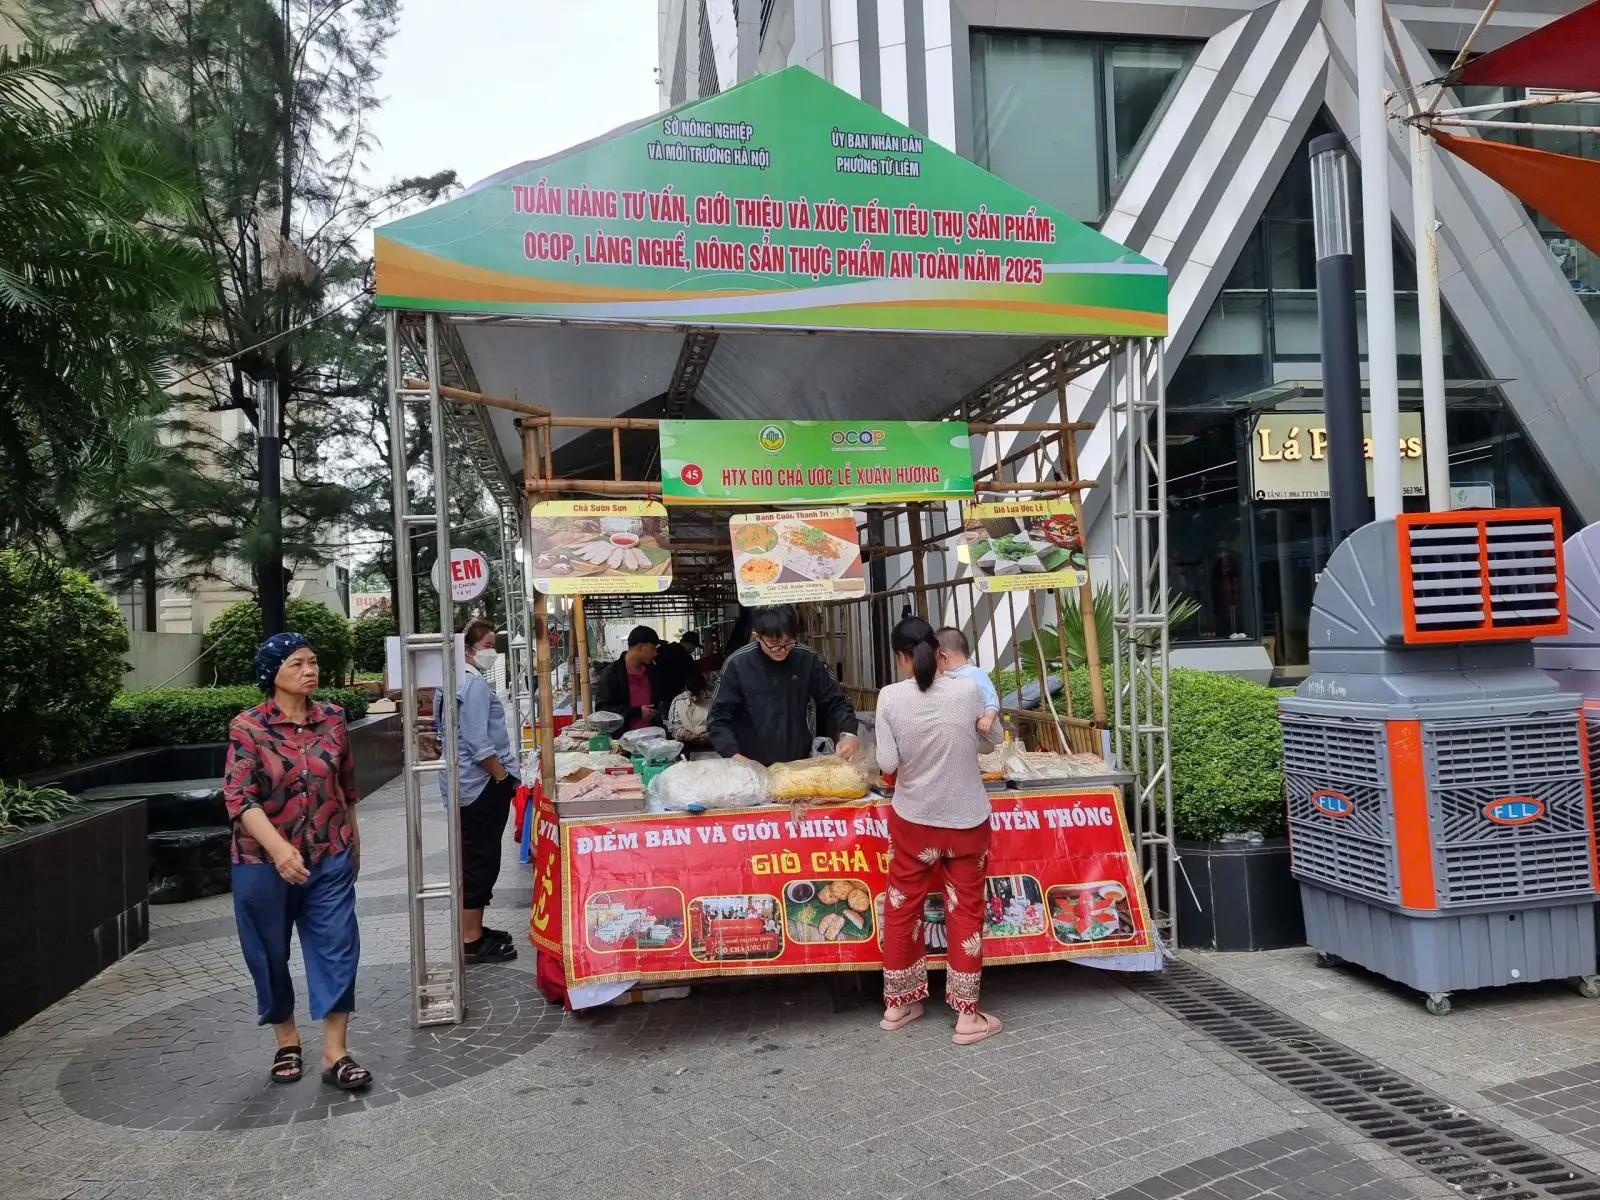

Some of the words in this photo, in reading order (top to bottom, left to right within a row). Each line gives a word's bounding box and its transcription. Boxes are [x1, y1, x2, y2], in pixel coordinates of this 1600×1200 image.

[663, 115, 681, 136] SỞ
[681, 117, 712, 138] NÔNG
[713, 120, 754, 144] NGHIỆP
[831, 126, 846, 148] ỦY
[847, 132, 869, 150] BAN
[871, 133, 900, 152] NHÂN
[901, 135, 923, 154] DÂN
[647, 140, 664, 160] VÀ
[665, 141, 687, 161] MÔI
[688, 143, 731, 164] TRƯỜNG
[733, 145, 749, 166] HÀ
[750, 147, 770, 171] NỘI
[836, 154, 878, 174] PHƯỜNG
[880, 156, 894, 176] TỪ
[895, 158, 920, 177] LIÊM
[512, 176, 562, 215] TUẦN
[567, 183, 617, 219] HÀNG
[621, 189, 646, 221] TƯ
[649, 184, 691, 227] VẤN,
[695, 190, 731, 226] GIỚI
[735, 194, 783, 234] THIỆU
[788, 195, 810, 231] VÀ
[814, 197, 848, 233] XÚC
[852, 198, 889, 235] TIẾN
[893, 202, 930, 237] TIÊU
[932, 207, 964, 245] THỤ
[967, 204, 1000, 241] SẢN
[1004, 205, 1056, 244] PHẨM:
[524, 230, 581, 267] OCOP,
[585, 229, 633, 266] LÀNG
[637, 230, 691, 272] NGHỀ,
[695, 235, 745, 271] NÔNG
[749, 236, 785, 273] SẢN
[789, 244, 832, 281] THỰC
[836, 239, 886, 279] PHẨM
[889, 251, 913, 280] AN
[916, 247, 960, 281] TOÀN
[963, 248, 1001, 282] NĂM
[1004, 256, 1044, 285] 2025
[831, 429, 885, 446] OCOP
[1257, 427, 1302, 461] Lá
[685, 470, 699, 481] 45
[722, 468, 748, 486] HTX
[751, 464, 774, 486] GIÒ
[777, 463, 804, 486] CHẢ
[807, 464, 833, 487] ƯỚC
[837, 461, 852, 486] LỄ
[856, 464, 892, 485] XUÂN
[896, 464, 940, 485] HƯƠNG
[449, 558, 482, 582] EM
[1319, 795, 1346, 812] FLL
[1494, 803, 1533, 819] FLL
[577, 828, 639, 855] ĐIỂM
[645, 825, 691, 848] BÁN
[696, 822, 727, 844] VÀ
[731, 819, 781, 842] GIỚI
[785, 815, 848, 842] THIỆU
[853, 812, 889, 839] SẢN
[990, 803, 1041, 831] UYỀN
[1043, 800, 1113, 828] THỐNG
[751, 848, 801, 875] GIÒ
[810, 843, 870, 873] CHẢ
